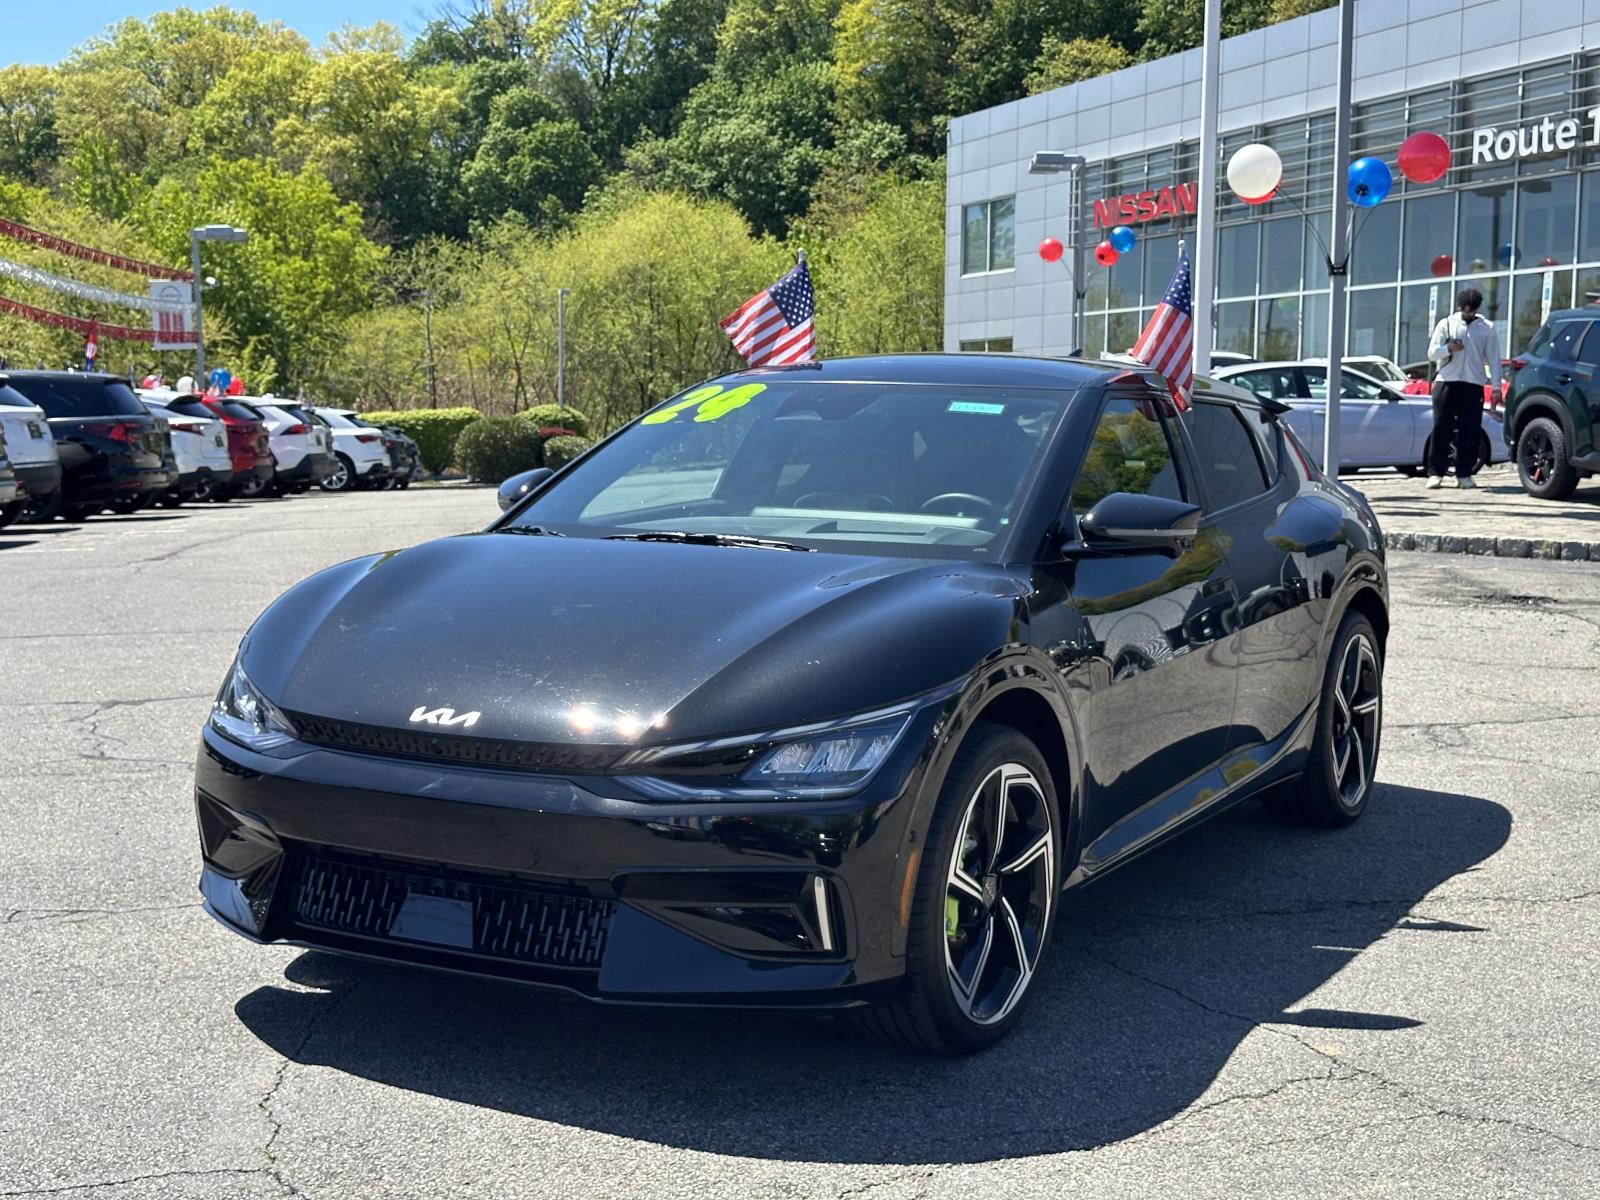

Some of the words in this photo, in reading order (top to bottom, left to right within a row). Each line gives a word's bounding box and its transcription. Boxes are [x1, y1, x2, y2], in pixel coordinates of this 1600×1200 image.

[1472, 117, 1580, 165] Route
[1093, 181, 1197, 231] NISSAN
[640, 383, 767, 425] 24
